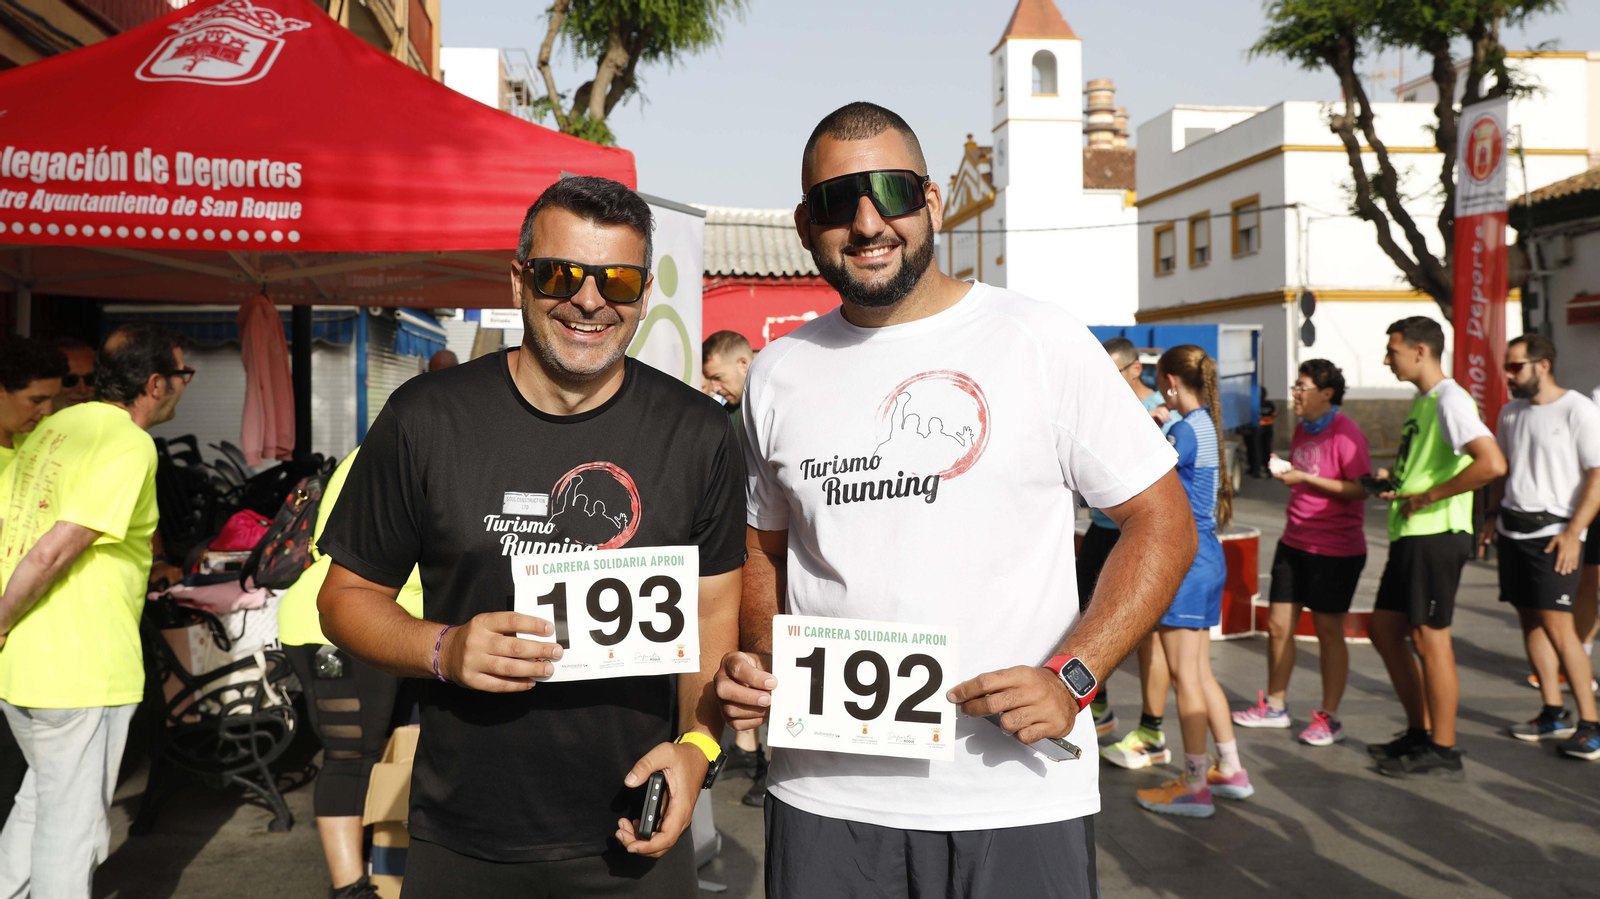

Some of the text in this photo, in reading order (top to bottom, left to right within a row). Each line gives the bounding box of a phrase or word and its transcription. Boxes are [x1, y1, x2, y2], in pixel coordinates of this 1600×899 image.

[0, 145, 302, 190] legación de Deportes
[29, 188, 169, 216] Ayuntamiento
[171, 195, 198, 216] de
[200, 195, 238, 218] San
[240, 196, 302, 221] Roque
[1466, 225, 1489, 341] Deporte
[800, 454, 883, 480] Turismo
[821, 470, 941, 506] Running
[483, 514, 556, 535] Turismo
[525, 555, 685, 576] VII CARRERA SOLIDARIA APRON
[537, 574, 685, 650] 193
[787, 625, 947, 646] VII CARRERA SOLIDARIA APRON
[795, 647, 944, 724] 192
